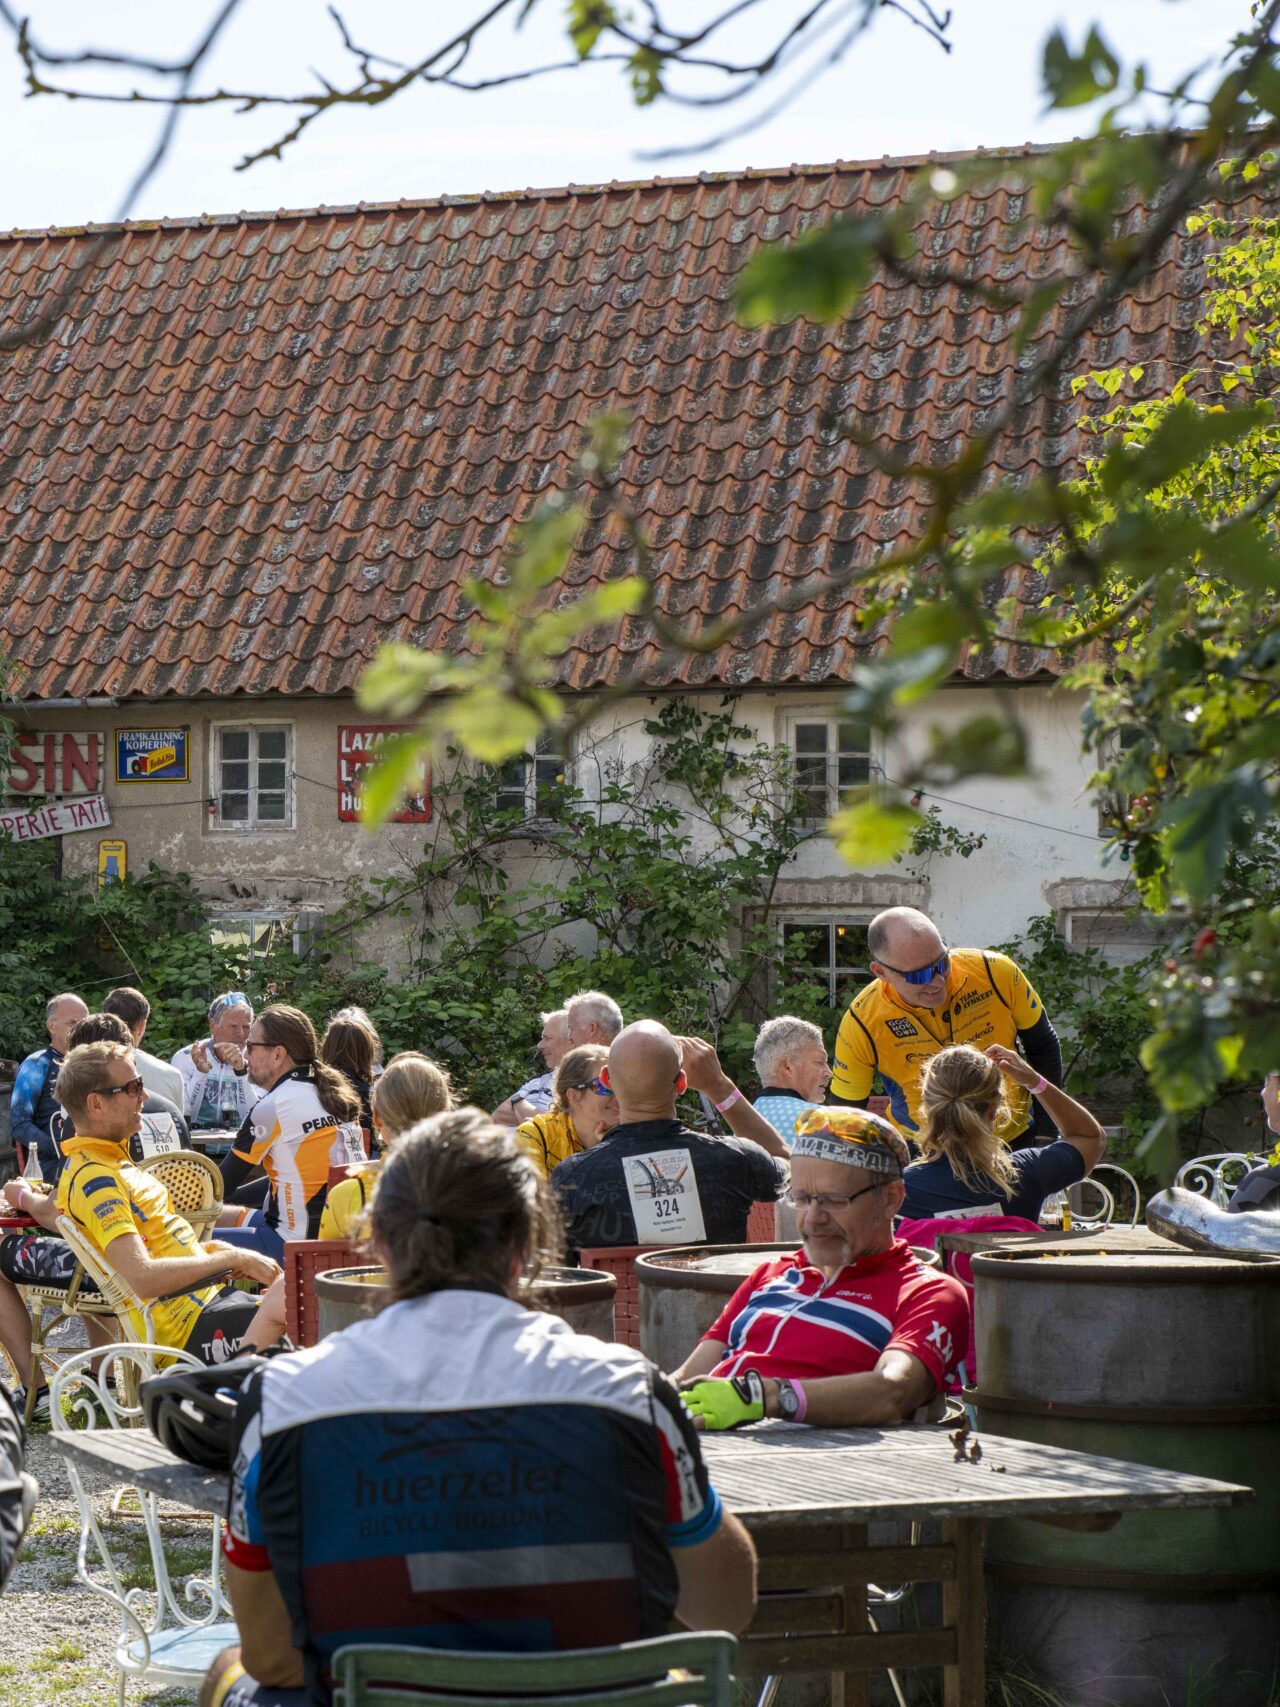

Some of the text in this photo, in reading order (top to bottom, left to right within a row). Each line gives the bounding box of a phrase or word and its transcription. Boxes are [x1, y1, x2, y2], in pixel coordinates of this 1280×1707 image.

[126, 740, 175, 750] KOPIERING
[960, 990, 978, 1004] TEAM
[963, 991, 993, 1009] RYNKEBY
[655, 1198, 679, 1218] 324
[354, 1456, 571, 1510] huerzeler
[359, 1504, 569, 1538] BICYCLE HOLIDAYS
